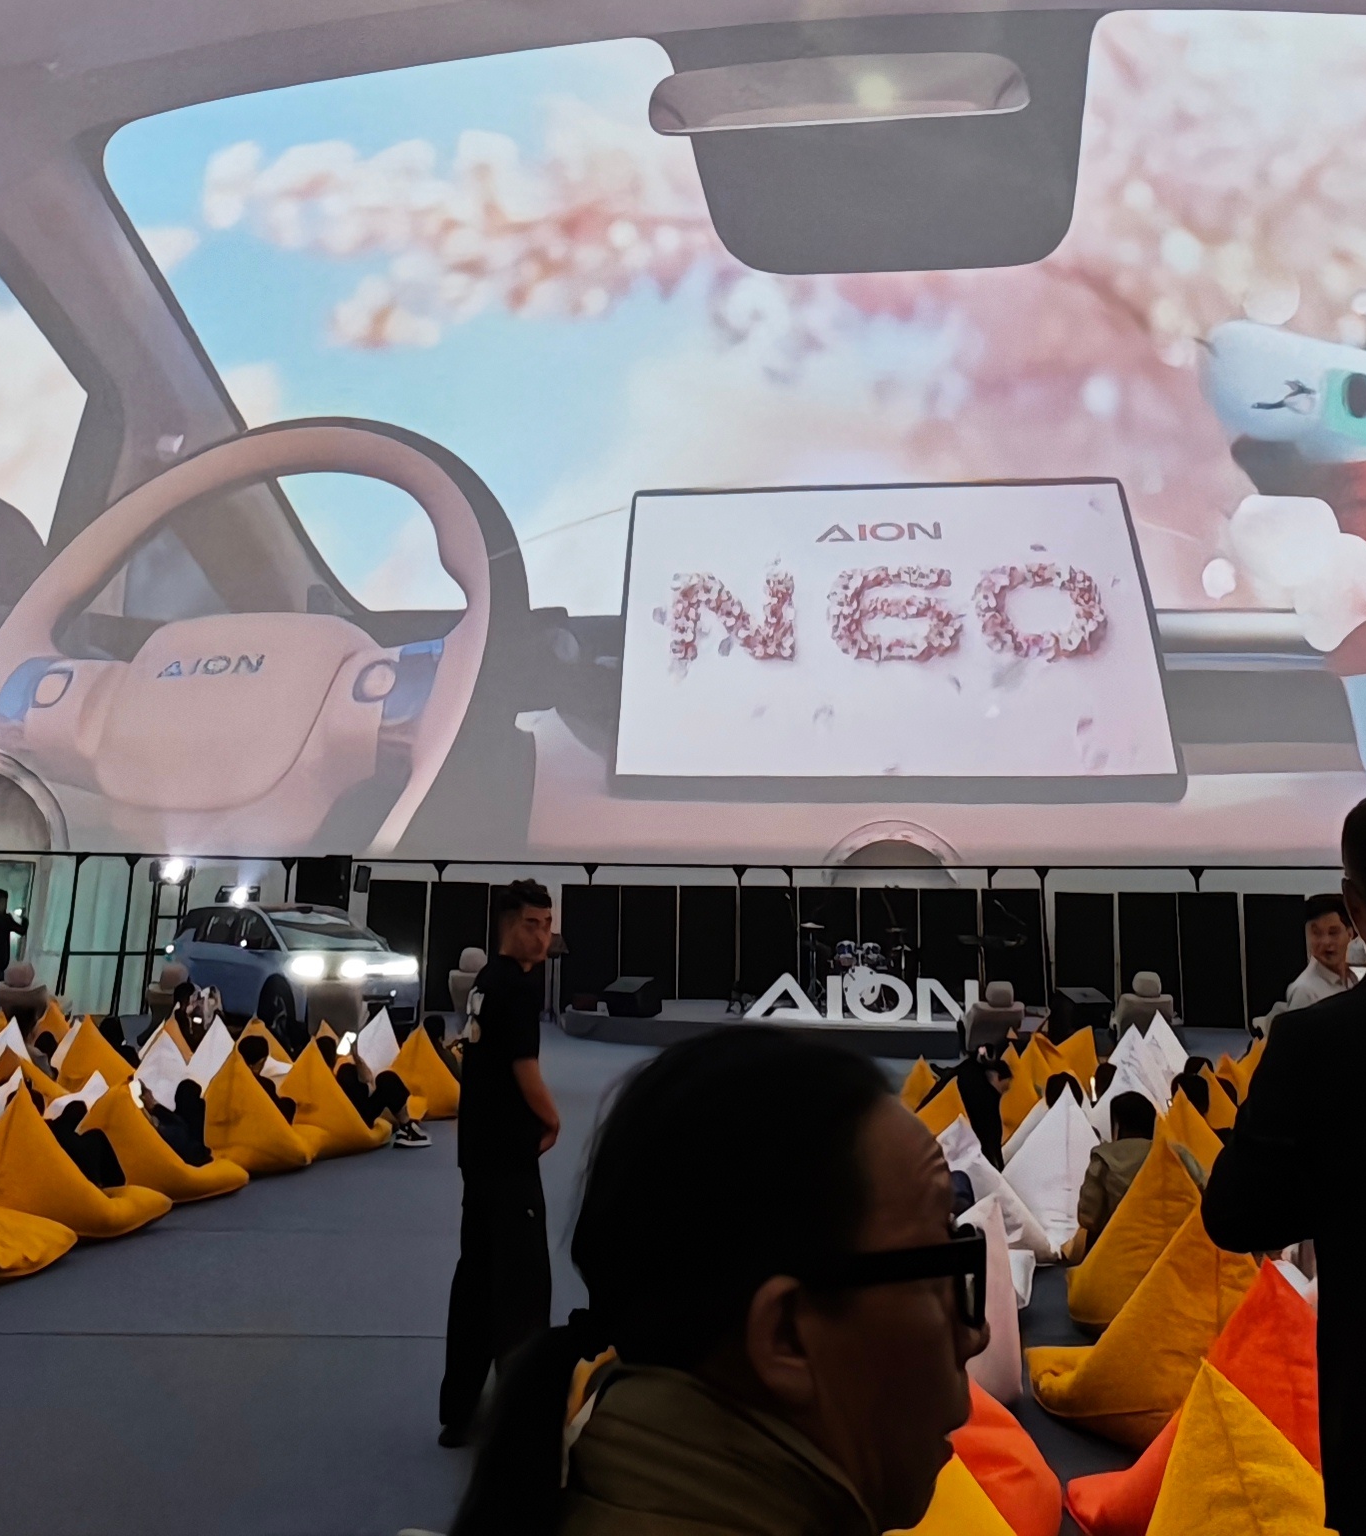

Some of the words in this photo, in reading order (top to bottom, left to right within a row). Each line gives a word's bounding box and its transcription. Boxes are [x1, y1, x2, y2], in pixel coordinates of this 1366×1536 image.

[815, 521, 942, 543] AION
[669, 563, 1109, 662] N60
[157, 654, 265, 678] AION
[743, 972, 980, 1024] AION
